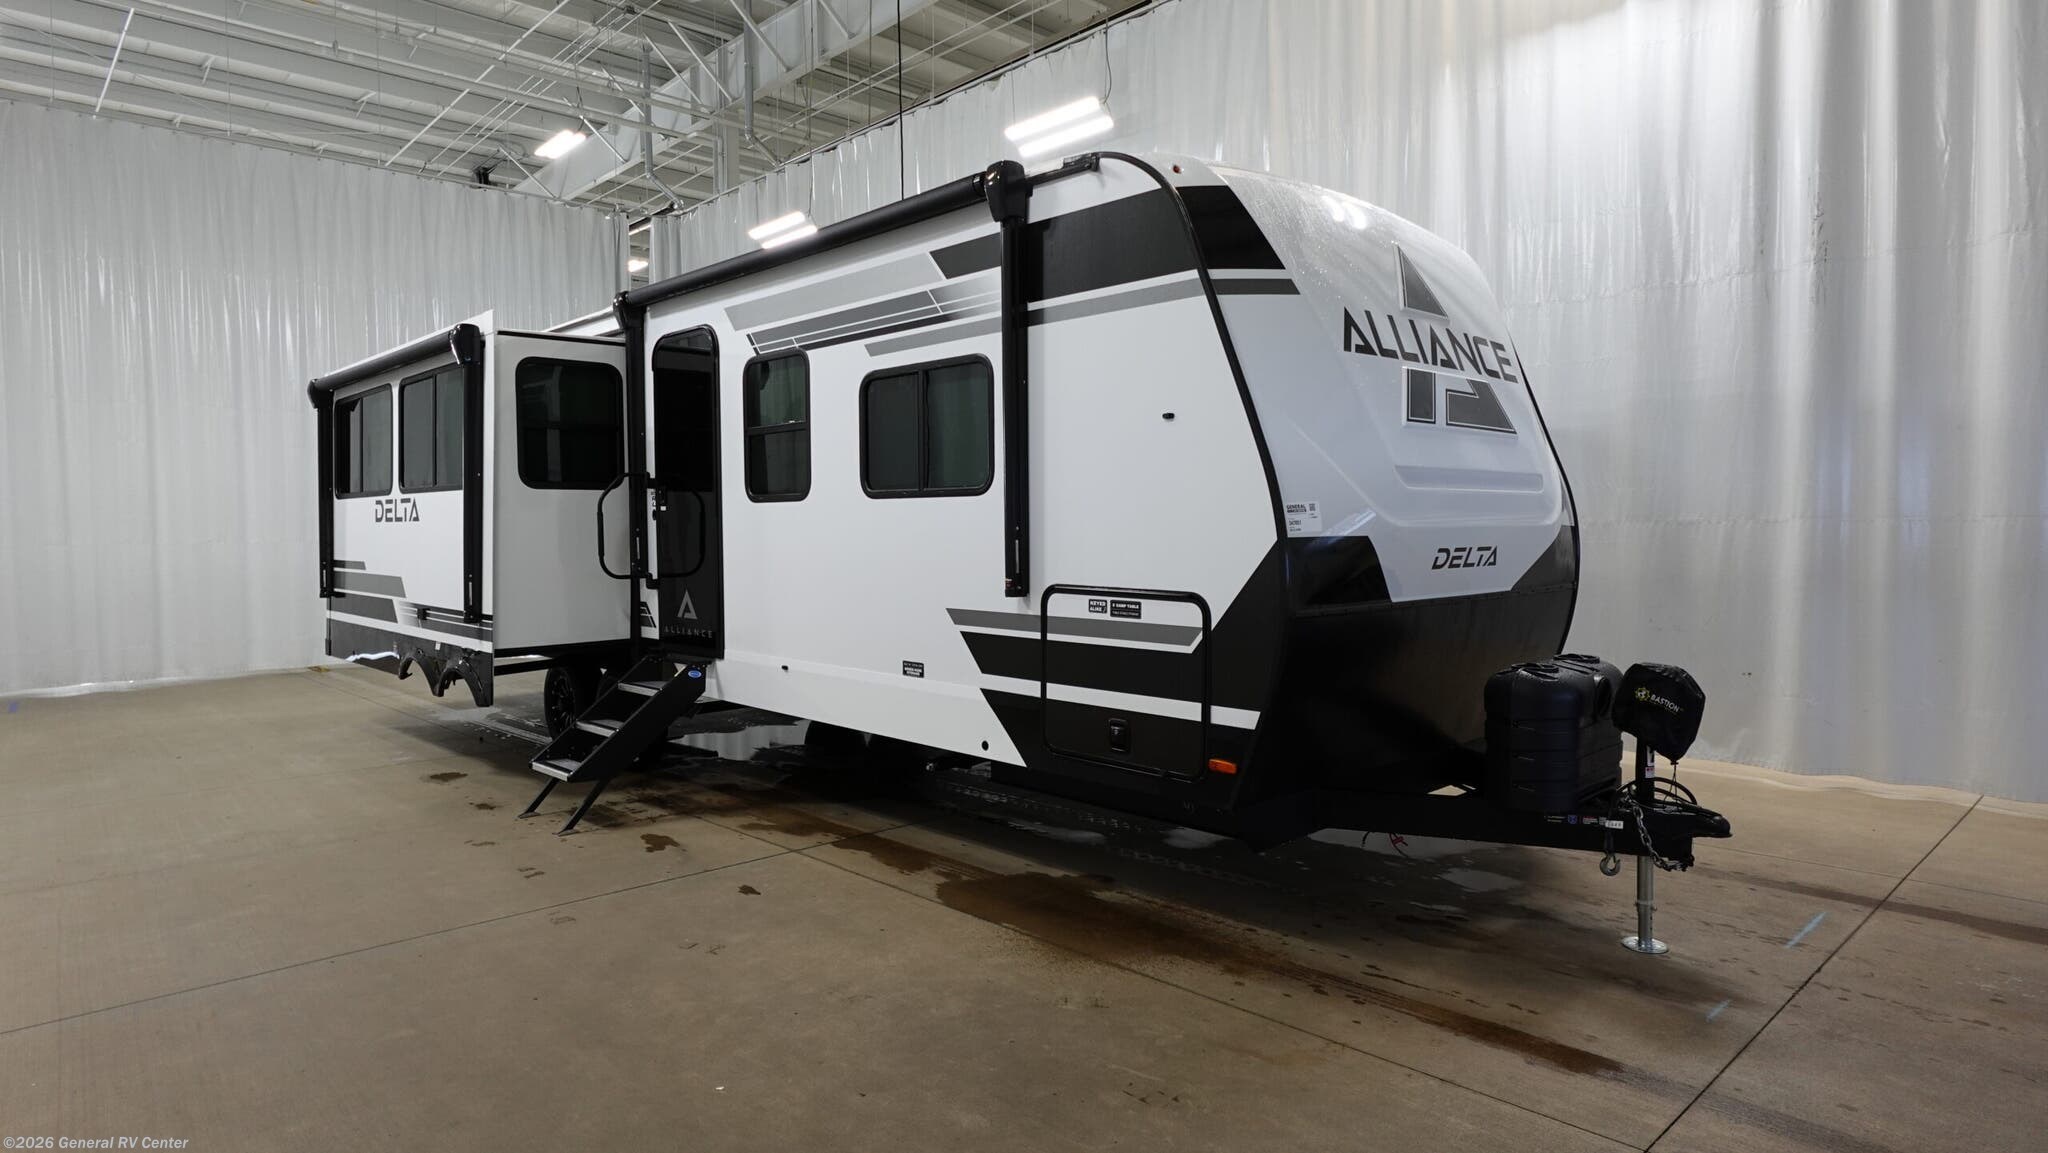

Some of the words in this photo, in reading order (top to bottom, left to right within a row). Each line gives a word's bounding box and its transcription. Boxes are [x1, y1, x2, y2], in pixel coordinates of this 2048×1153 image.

[1343, 305, 1519, 384] ALLIANCE
[375, 497, 420, 522] DELTA
[1431, 545, 1498, 570] DELTA
[664, 625, 713, 638] ALLIANCE
[1650, 694, 1680, 712] BASTION
